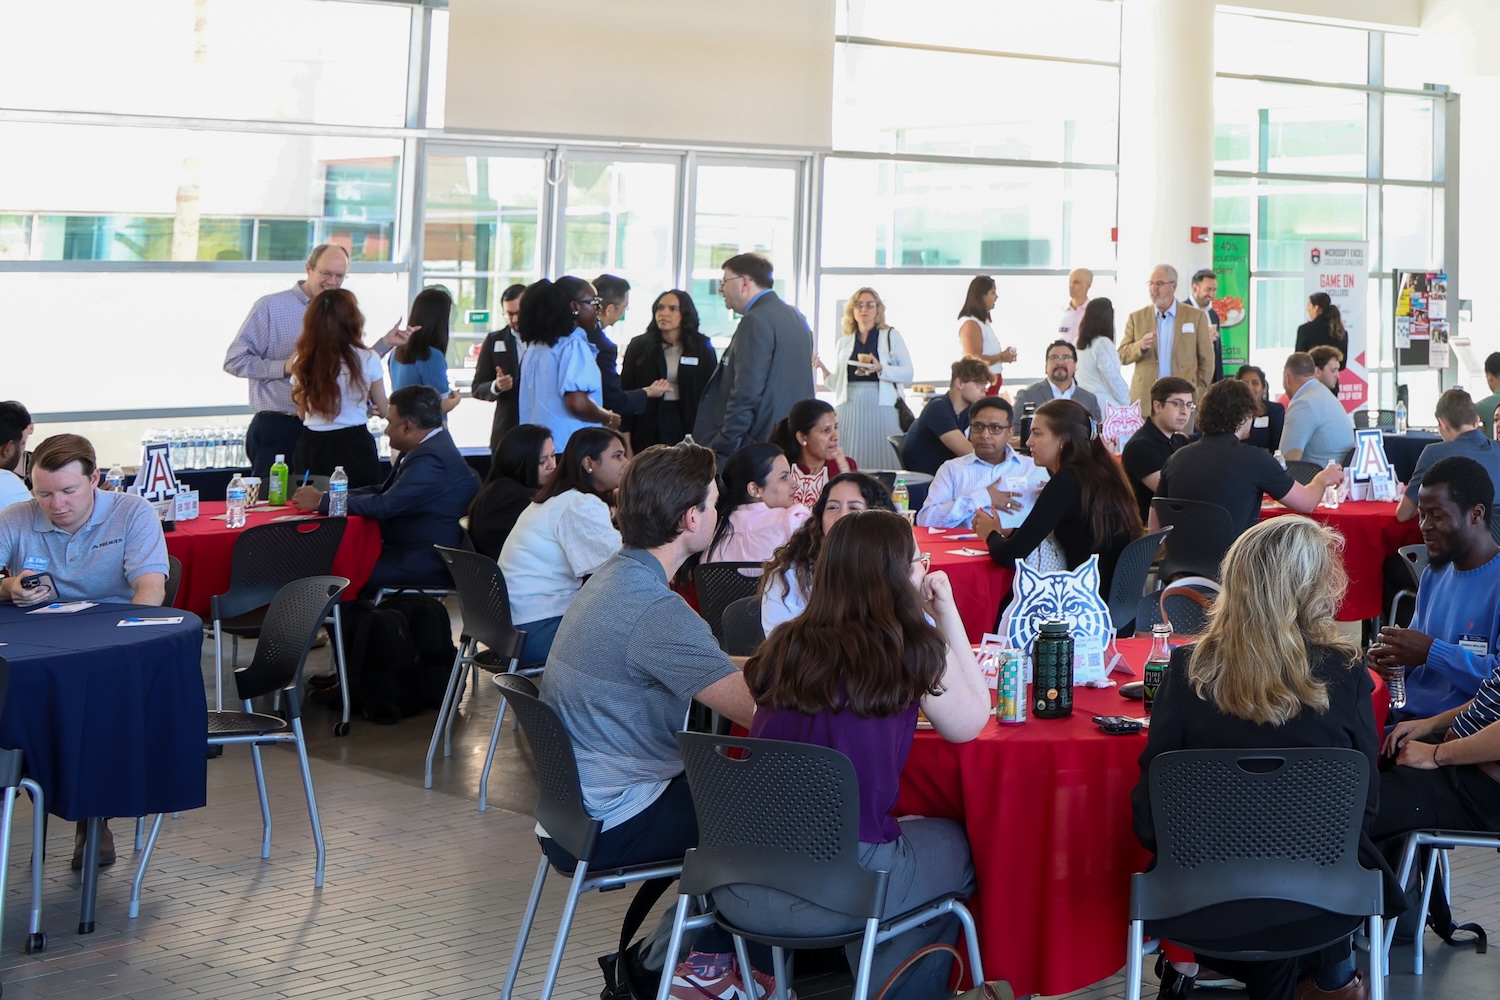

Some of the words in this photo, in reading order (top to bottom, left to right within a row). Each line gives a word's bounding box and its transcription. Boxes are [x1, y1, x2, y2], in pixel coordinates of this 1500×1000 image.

[1351, 249, 1363, 257] EXCEL
[1320, 274, 1341, 288] GAME
[1344, 274, 1354, 288] ON
[140, 444, 181, 503] A
[98, 538, 122, 548] PREMIER
